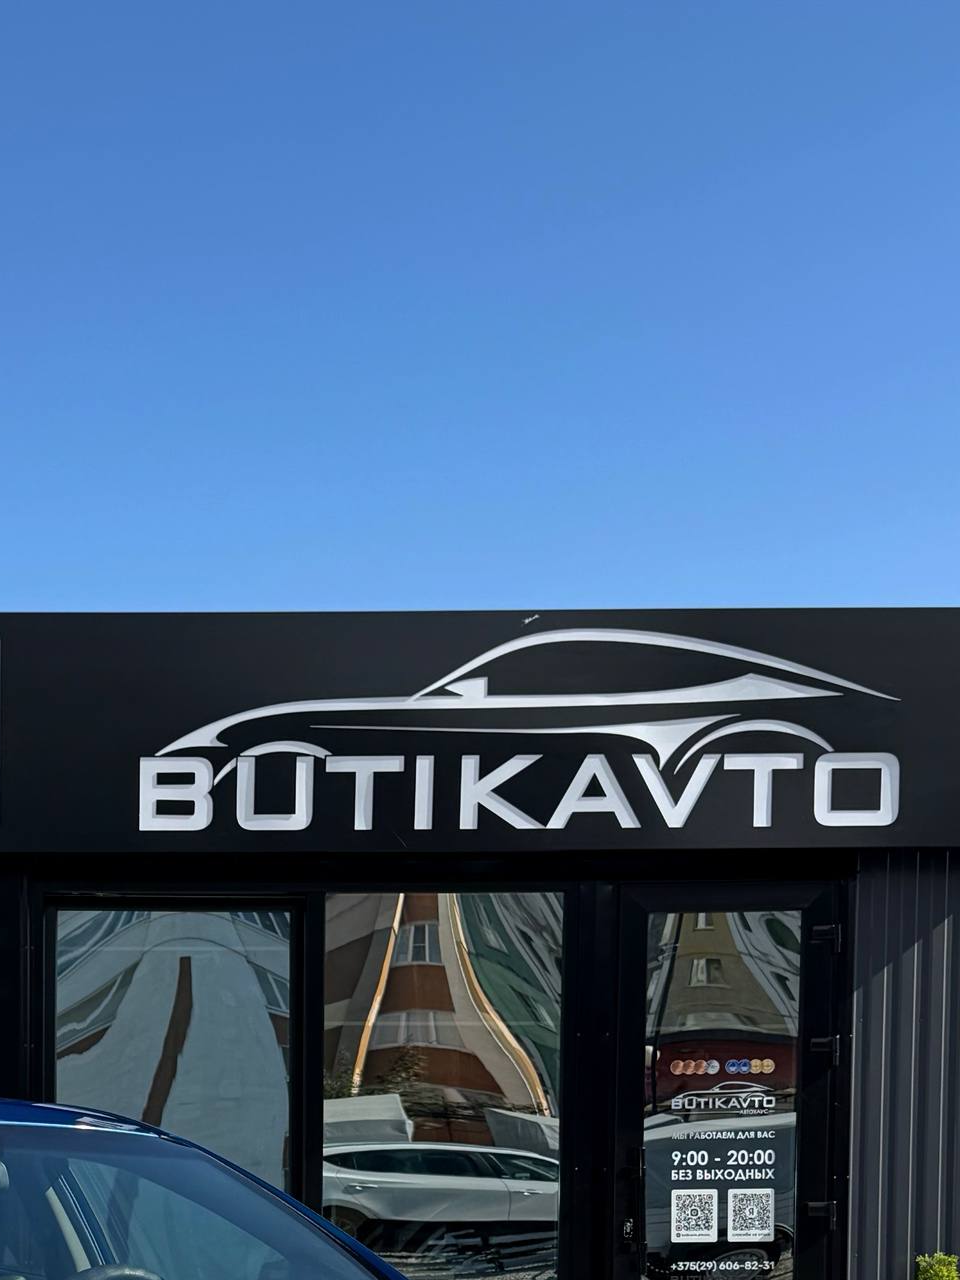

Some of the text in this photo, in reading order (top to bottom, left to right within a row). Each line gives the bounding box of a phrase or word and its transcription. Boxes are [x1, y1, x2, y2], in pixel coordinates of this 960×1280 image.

[139, 752, 900, 831] BUTIKAVTO
[671, 1097, 776, 1109] BUTIKAVTO
[672, 1130, 776, 1140] МЫ РАБОТАЕМ ДЛЯ ВАС
[671, 1151, 708, 1166] 9:00
[726, 1150, 776, 1165] 20:00
[671, 1168, 776, 1181] БЕЗ ВЫХОДНЫХ
[670, 1261, 775, 1272] +375(29) 606-82-31
